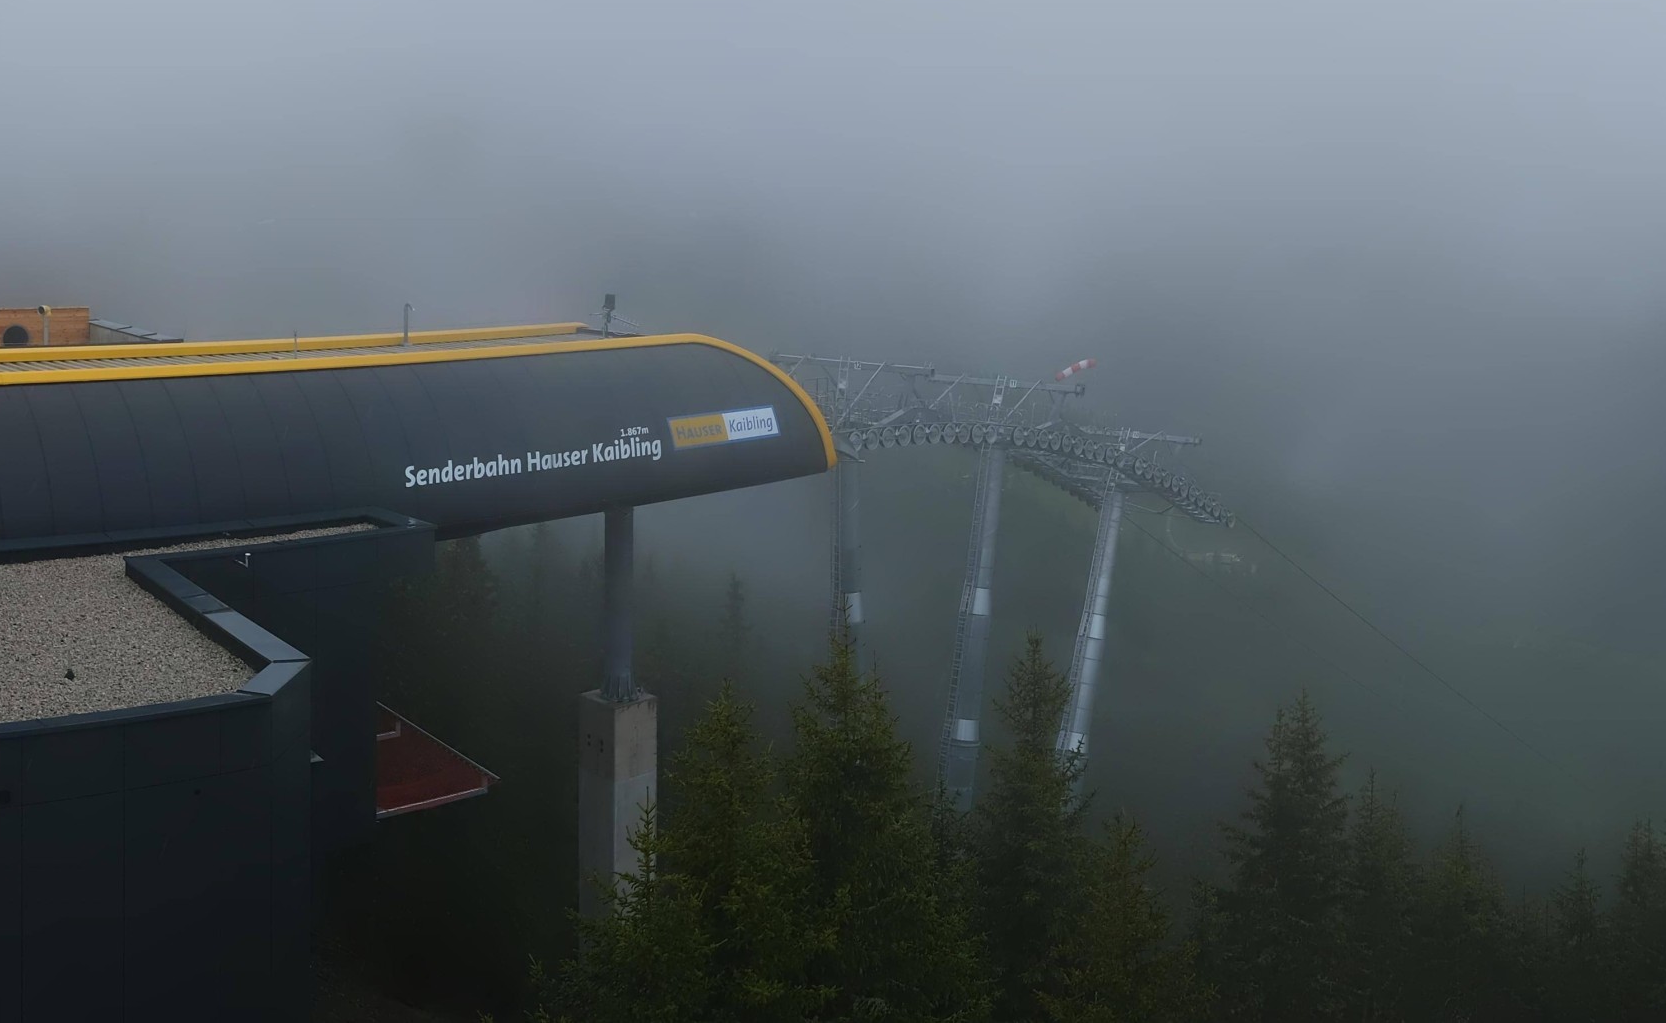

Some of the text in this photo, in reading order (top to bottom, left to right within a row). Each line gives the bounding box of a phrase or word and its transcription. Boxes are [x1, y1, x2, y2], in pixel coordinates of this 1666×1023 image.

[620, 426, 649, 437] 1.867m
[676, 416, 773, 440] HAUSER Kaibling
[405, 437, 662, 488] Senderbahn Hauser Kaibling
